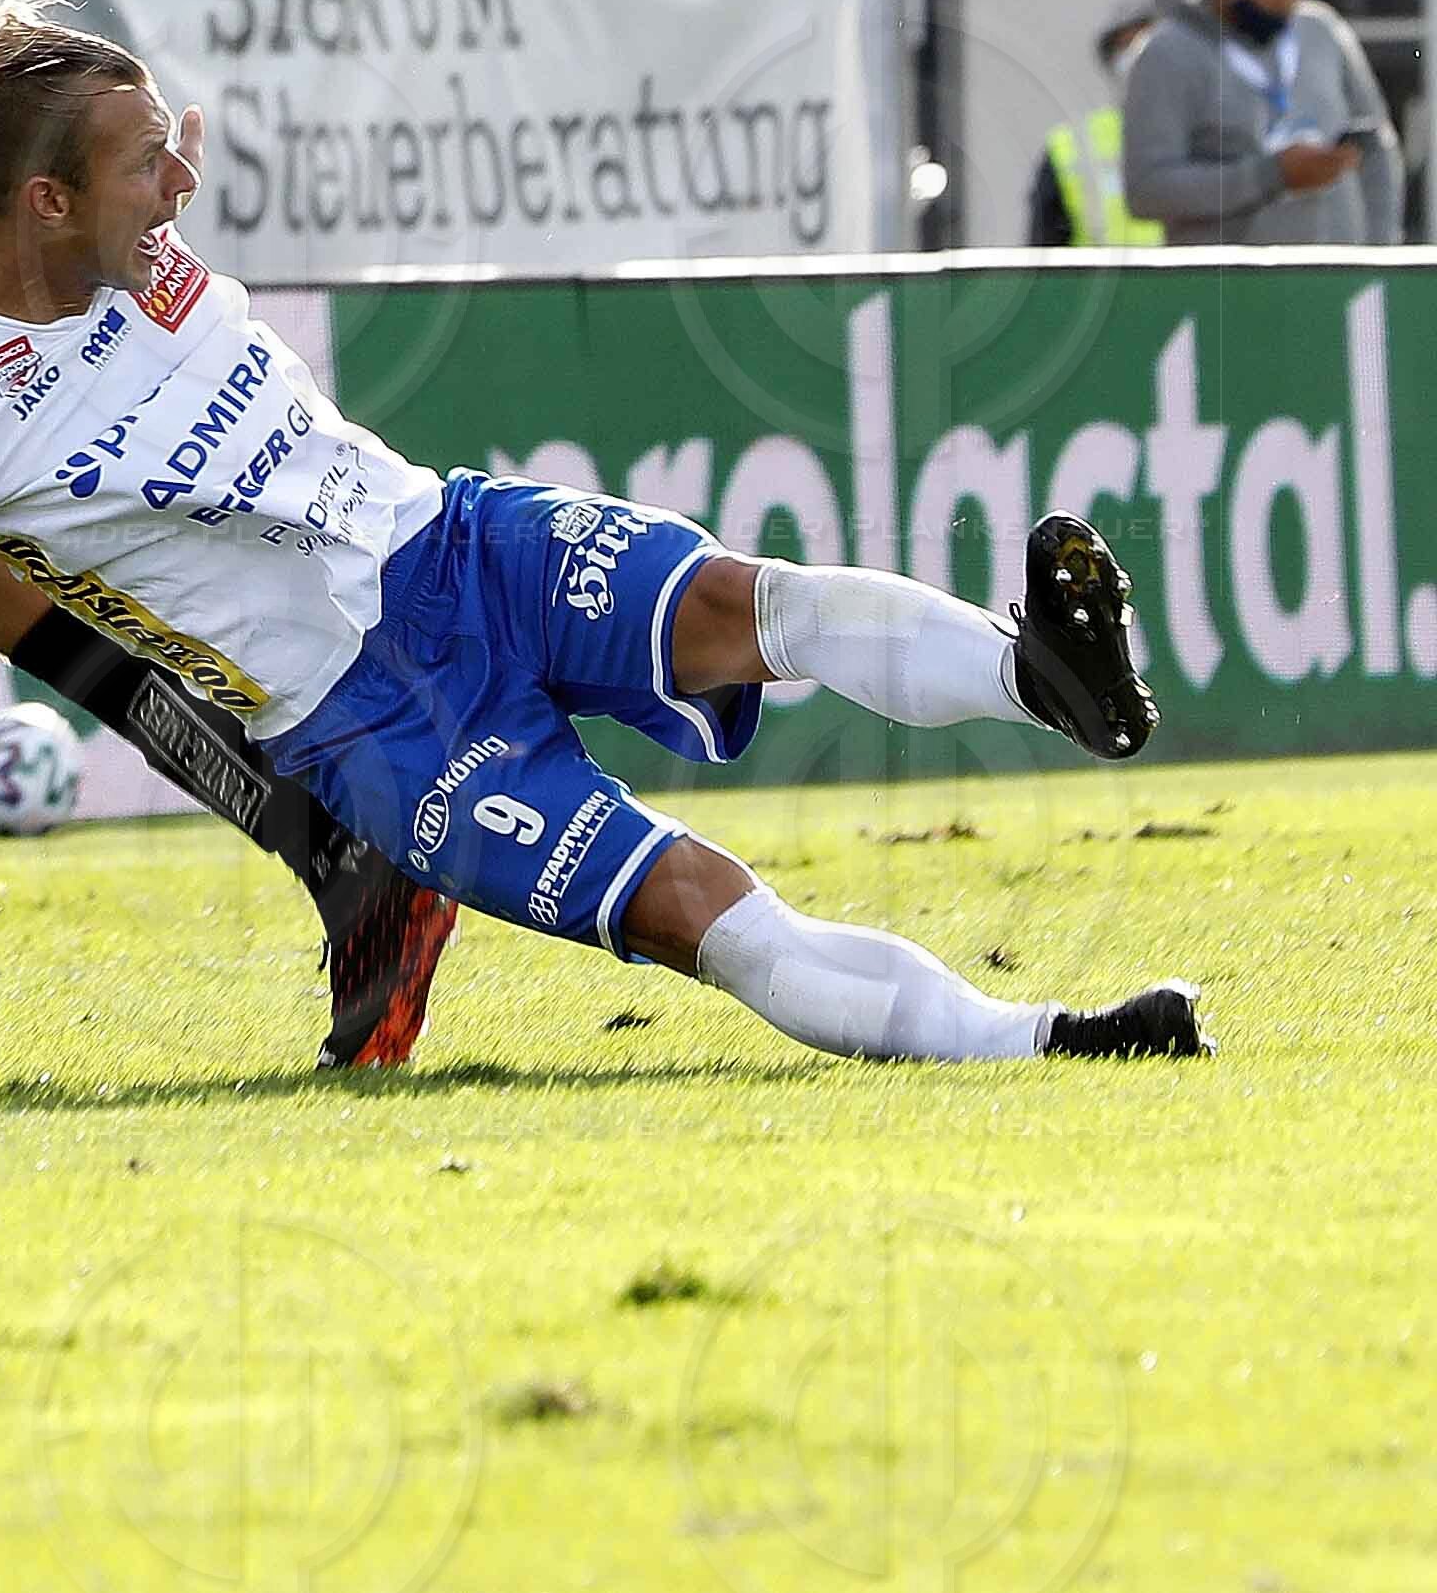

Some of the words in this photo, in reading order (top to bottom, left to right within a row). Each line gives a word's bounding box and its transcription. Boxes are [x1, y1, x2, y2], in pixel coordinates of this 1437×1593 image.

[215, 72, 829, 245] Steuerberatung
[11, 365, 61, 421] JAKO
[418, 801, 446, 846] KIA
[472, 793, 546, 847] 9
